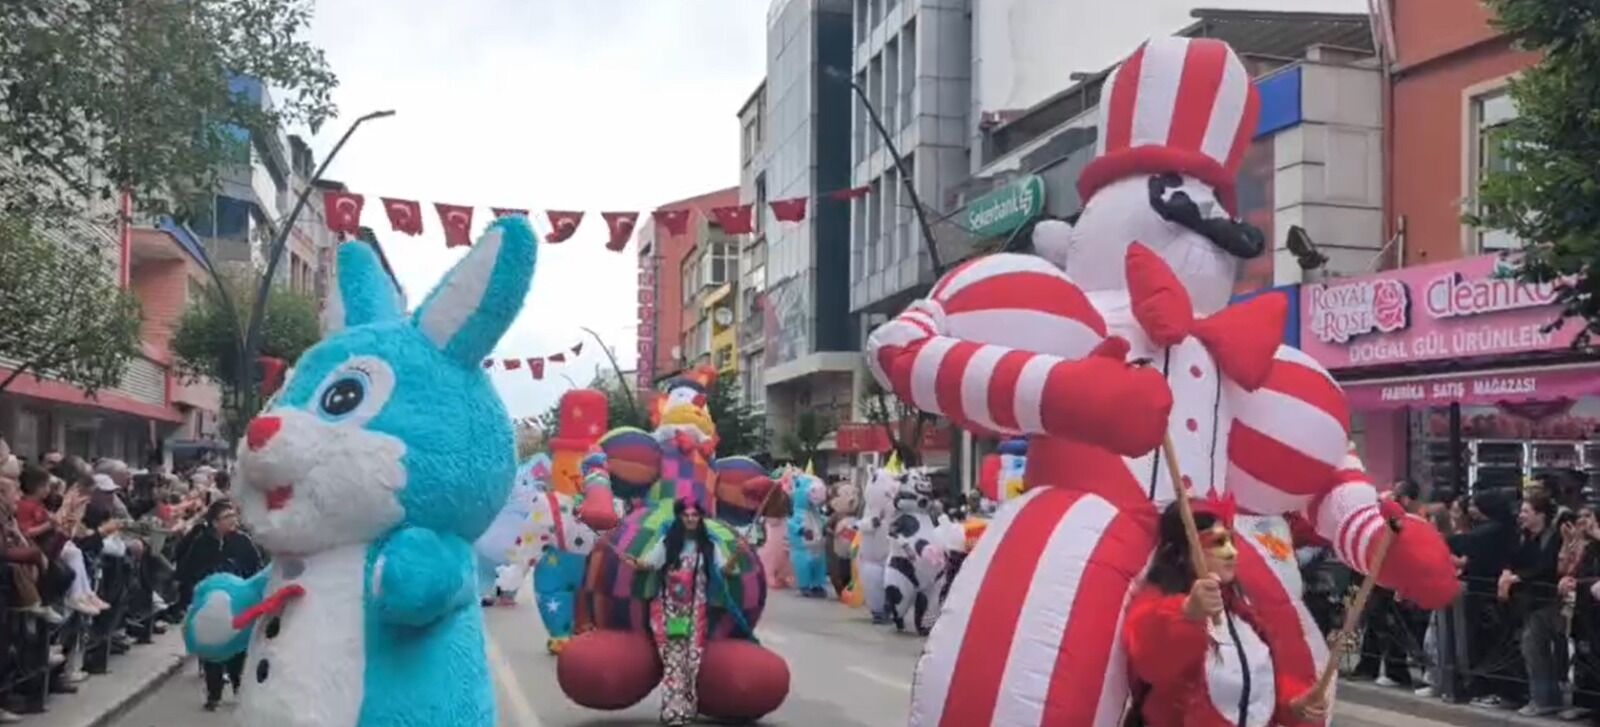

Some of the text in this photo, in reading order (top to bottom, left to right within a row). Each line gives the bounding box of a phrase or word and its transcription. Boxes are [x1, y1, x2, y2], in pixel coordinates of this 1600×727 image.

[1312, 285, 1367, 310] ROYAL
[1323, 311, 1369, 339] ROSE
[1349, 321, 1552, 363] DOĞAL GÜL ÜRÜNLERİ
[1381, 377, 1537, 401] FABRİKA SATIŞ MAĞAZASI
